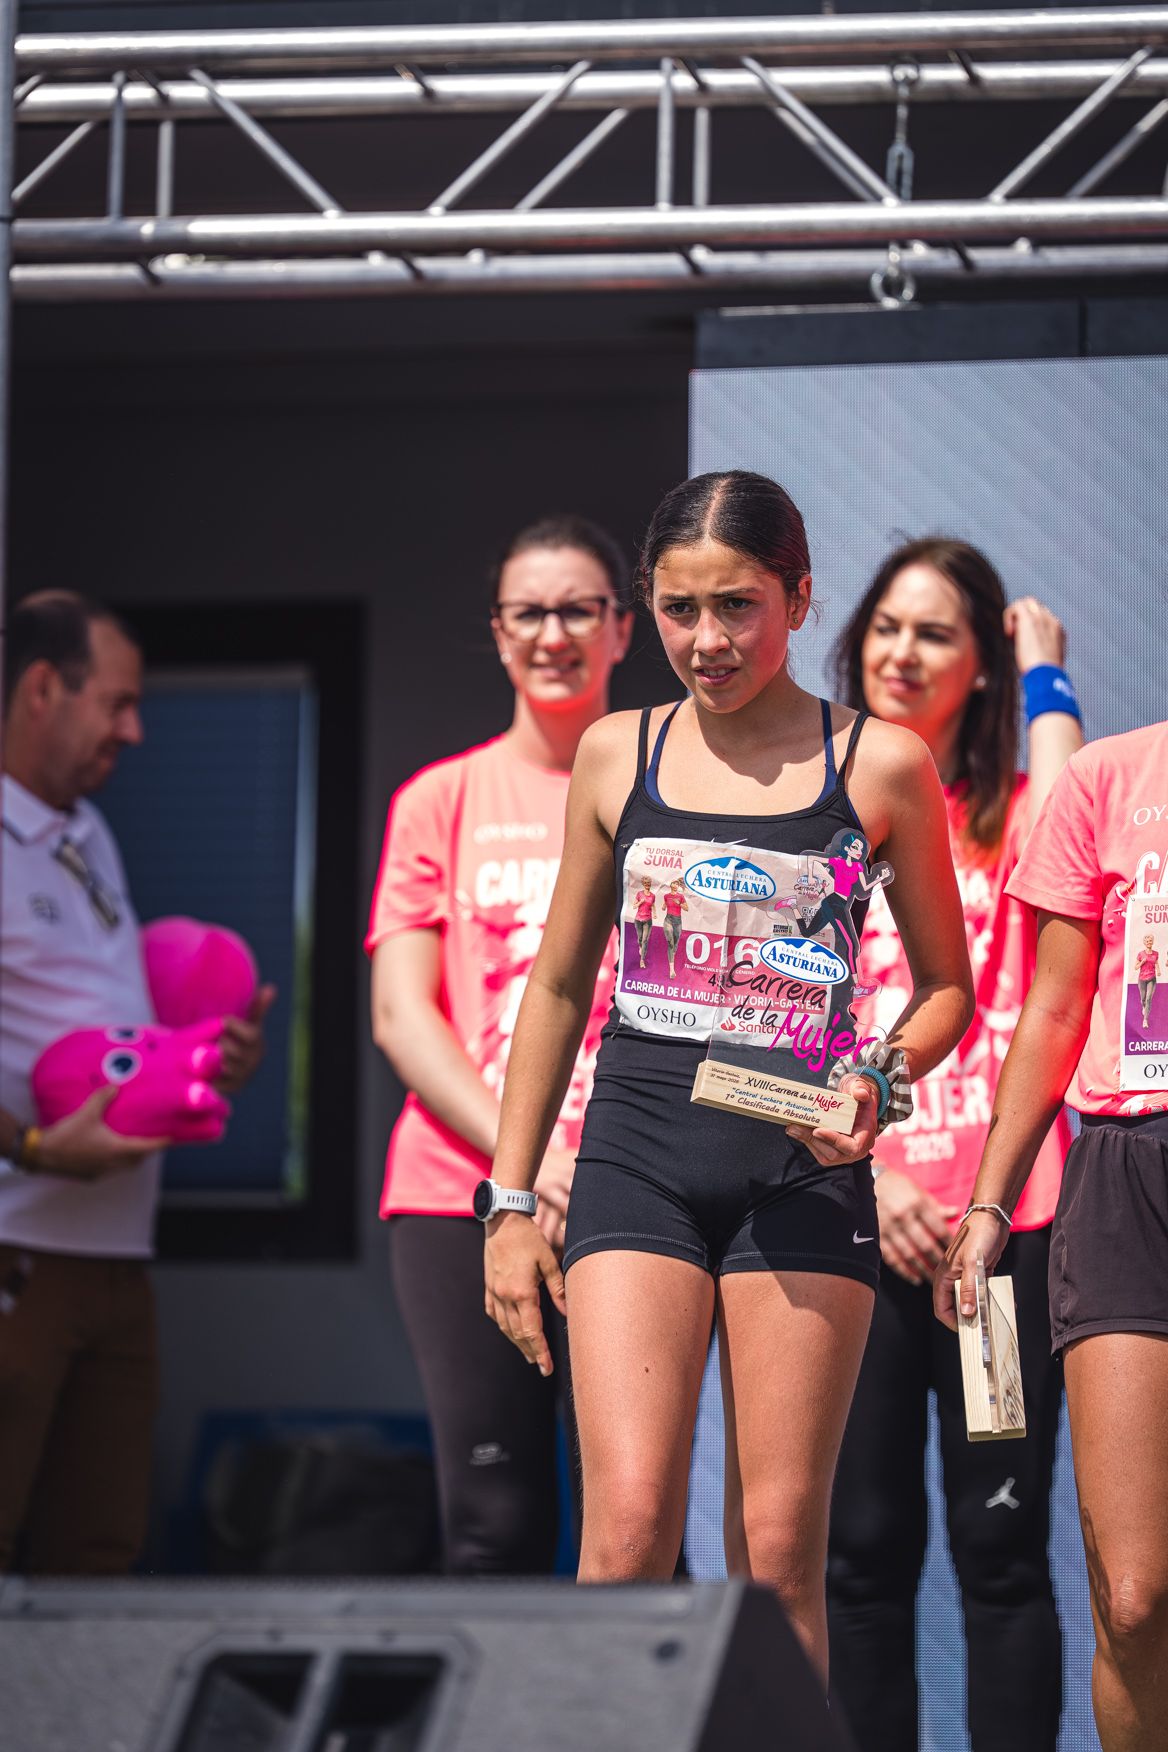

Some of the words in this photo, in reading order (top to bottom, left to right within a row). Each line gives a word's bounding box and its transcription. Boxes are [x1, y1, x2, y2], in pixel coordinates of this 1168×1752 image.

[643, 854, 683, 870] SUMA
[645, 847, 655, 855] TU
[655, 848, 684, 858] DORSAL
[766, 945, 838, 979] ASTURIANA
[624, 979, 665, 995] CARRERA
[666, 985, 679, 997] DE
[680, 986, 692, 999] LA
[694, 988, 726, 1004] MUJER
[729, 960, 828, 1009] Carrera
[637, 1004, 697, 1027] OYSHO
[731, 996, 755, 1020] de
[760, 1000, 779, 1027] la
[767, 1004, 879, 1073] Mujer
[744, 1076, 770, 1090] XVIII
[768, 1083, 799, 1098] Carrera
[799, 1092, 807, 1100] de
[807, 1093, 815, 1102] la
[812, 1092, 845, 1112] Mujer
[737, 1096, 780, 1114] Clasificada
[783, 1108, 821, 1124] Absoluta
